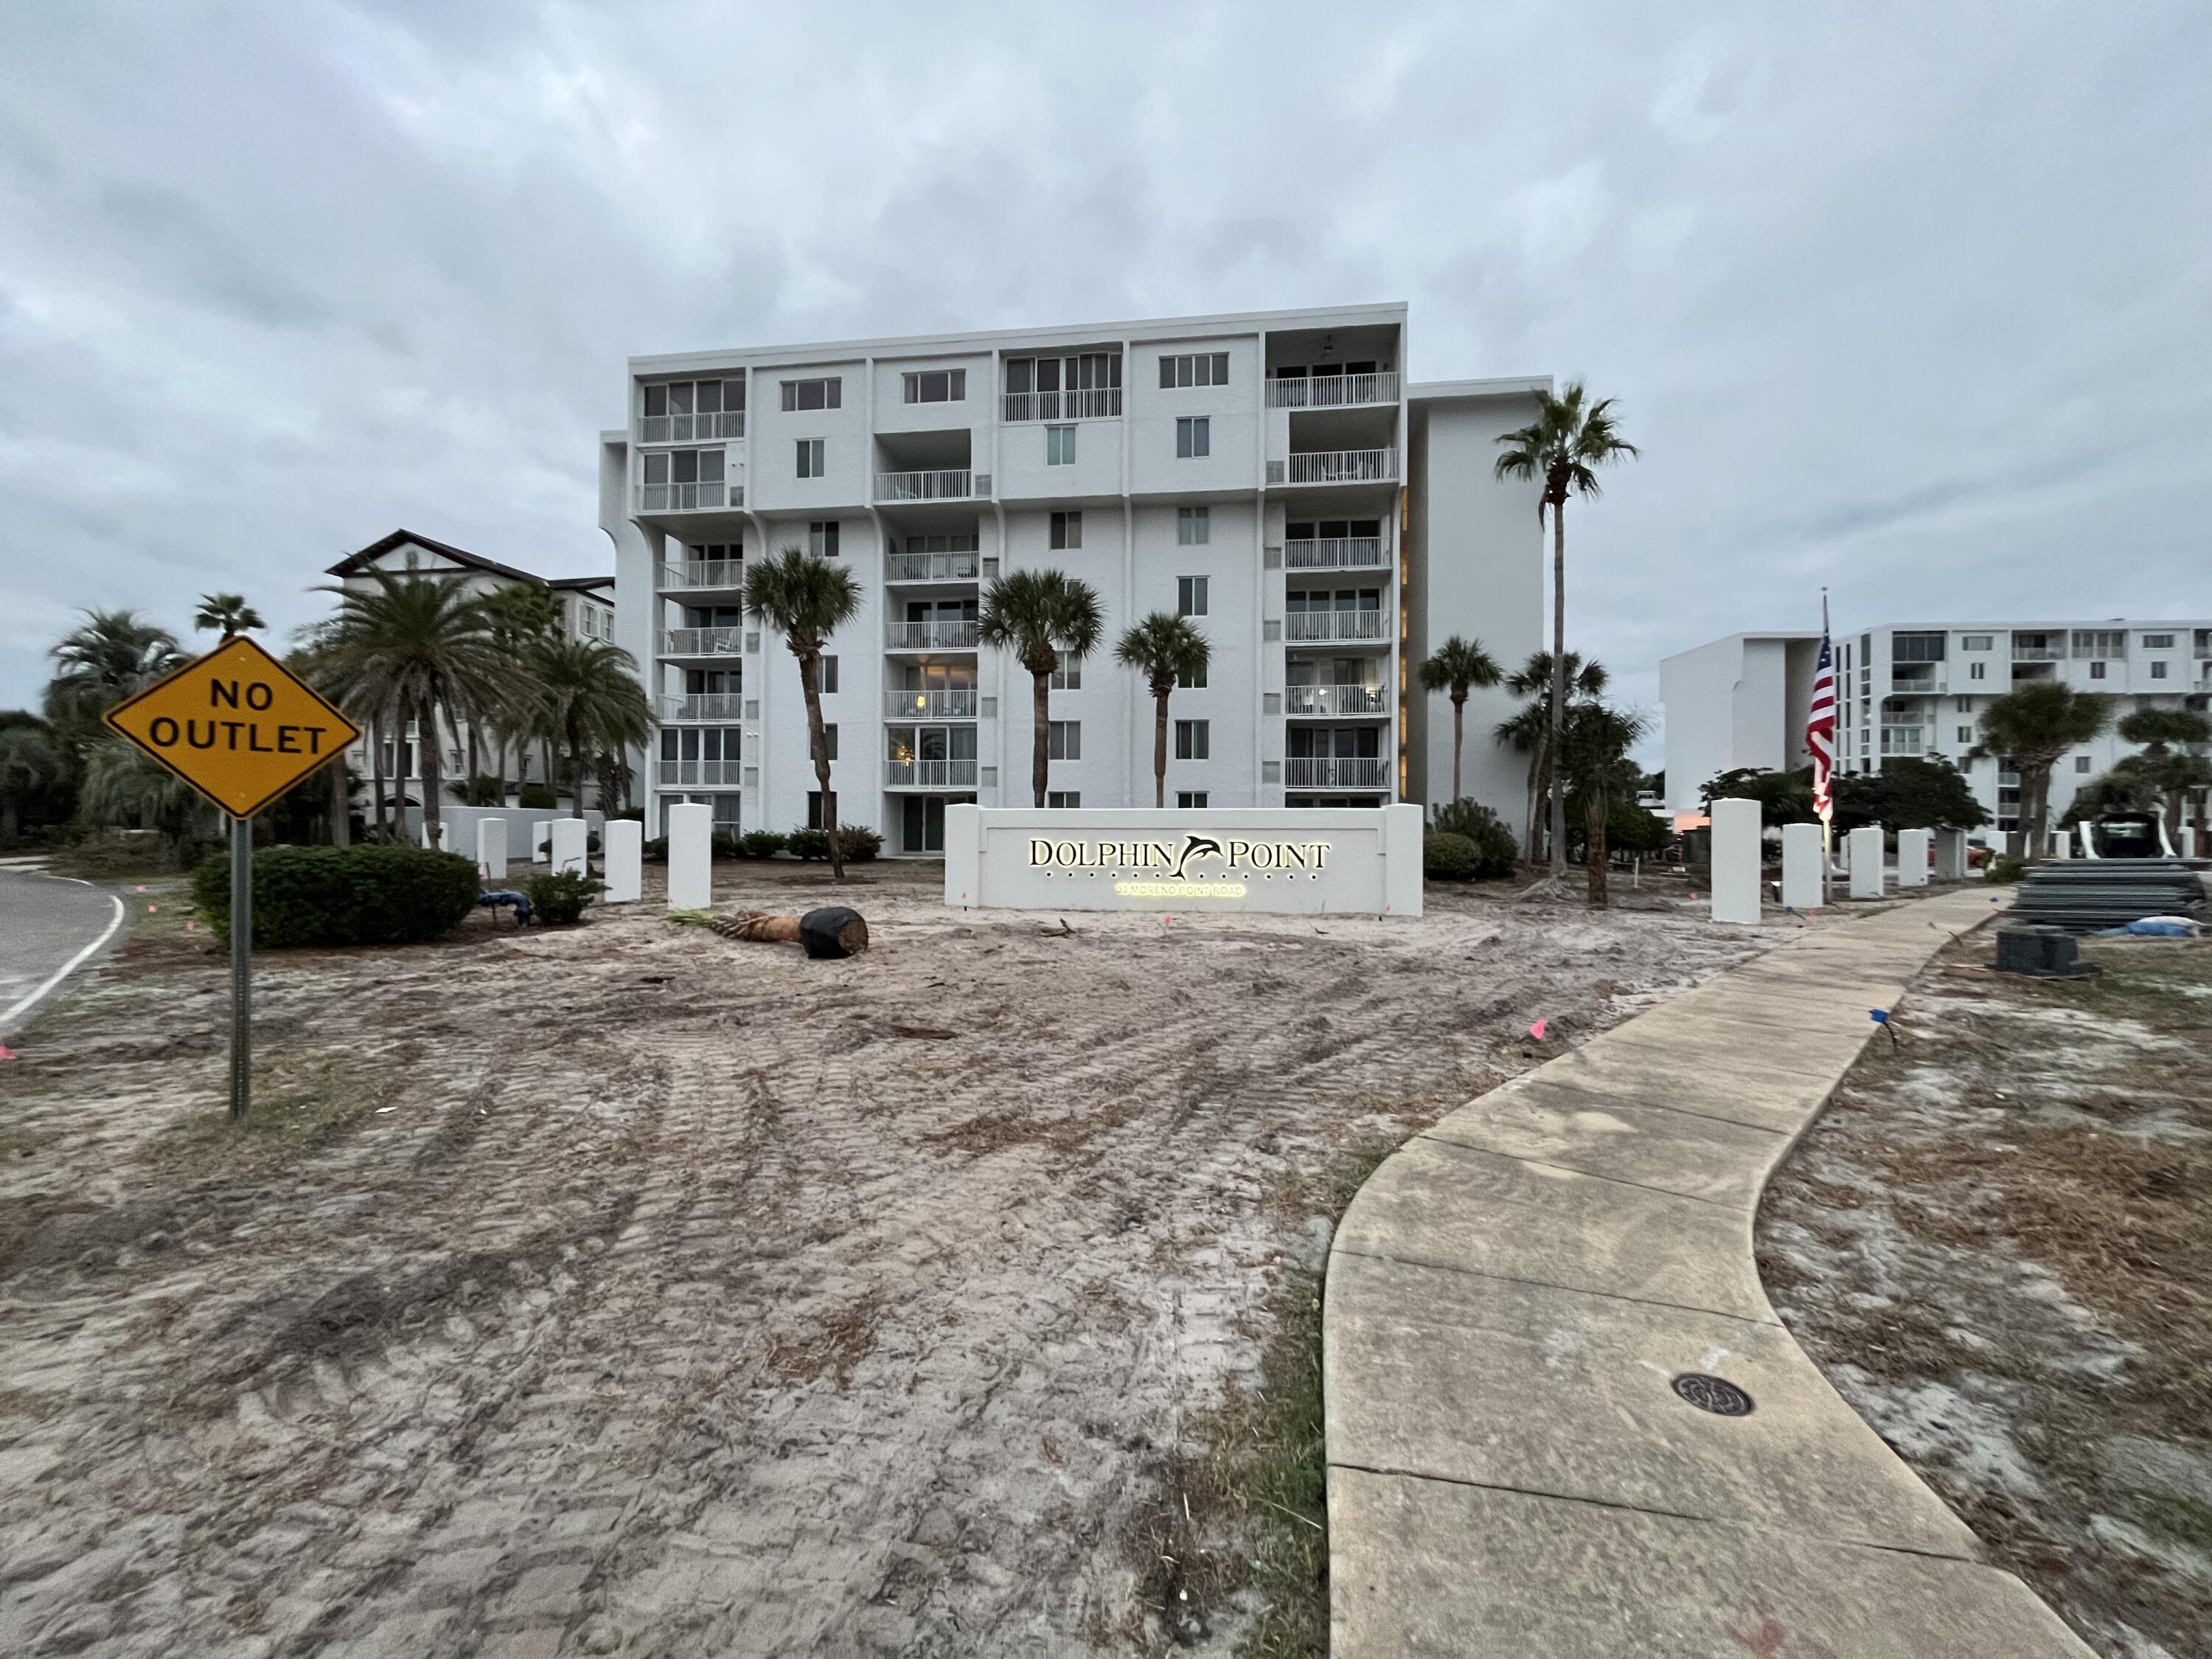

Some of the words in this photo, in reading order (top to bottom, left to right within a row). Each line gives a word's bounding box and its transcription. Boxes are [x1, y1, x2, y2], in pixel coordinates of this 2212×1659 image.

[211, 678, 273, 711] NO
[150, 717, 327, 754] OUTLET
[1130, 886, 1176, 894] MORENO
[1180, 886, 1209, 894] POINT
[1213, 886, 1243, 895] ROAD
